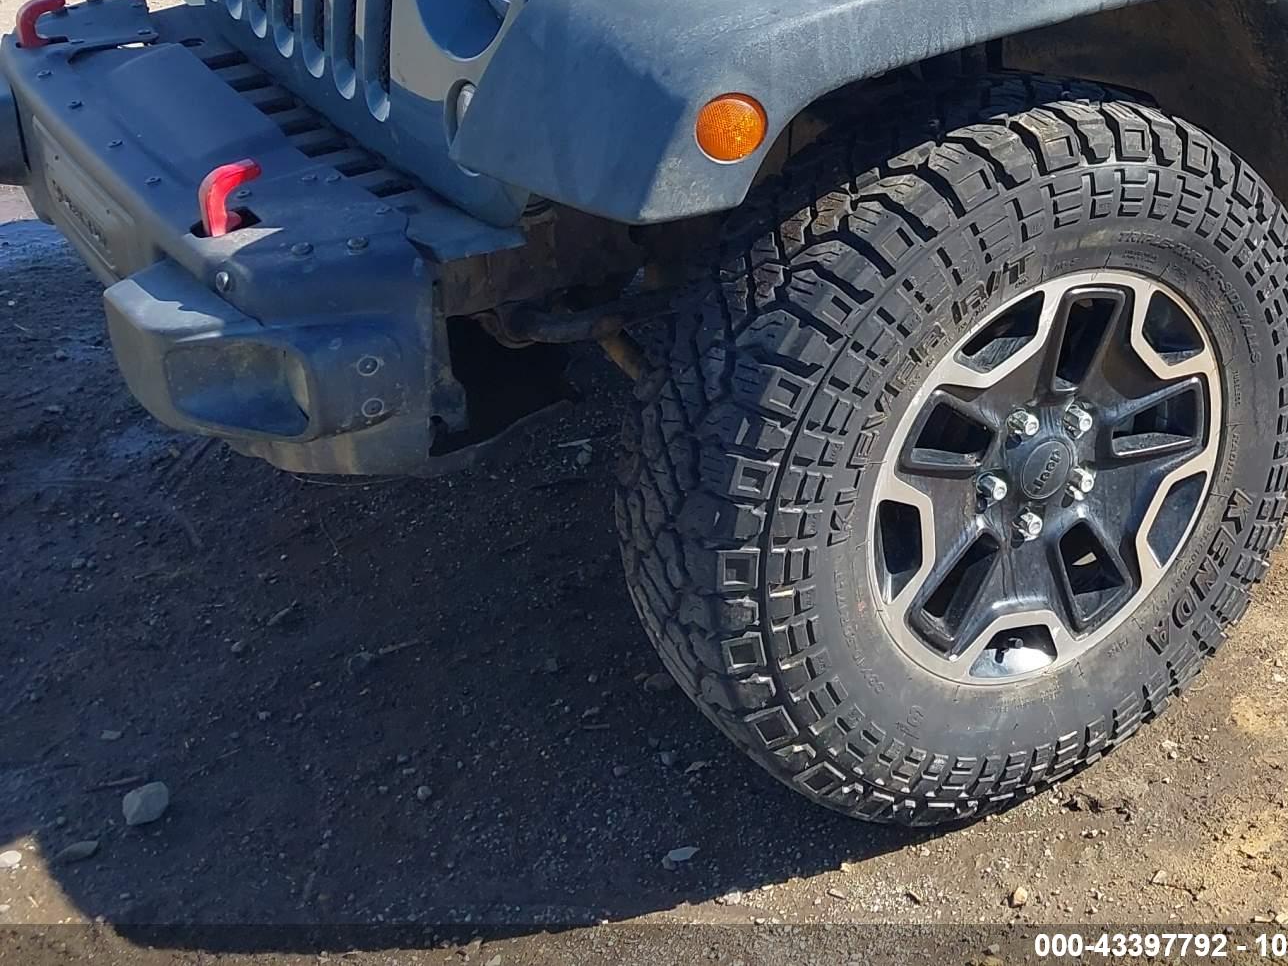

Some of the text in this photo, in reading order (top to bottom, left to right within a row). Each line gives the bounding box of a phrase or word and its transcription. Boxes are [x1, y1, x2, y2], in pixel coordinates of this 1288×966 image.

[827, 247, 1036, 548] KLEVER R/T
[1146, 487, 1253, 655] KENDA
